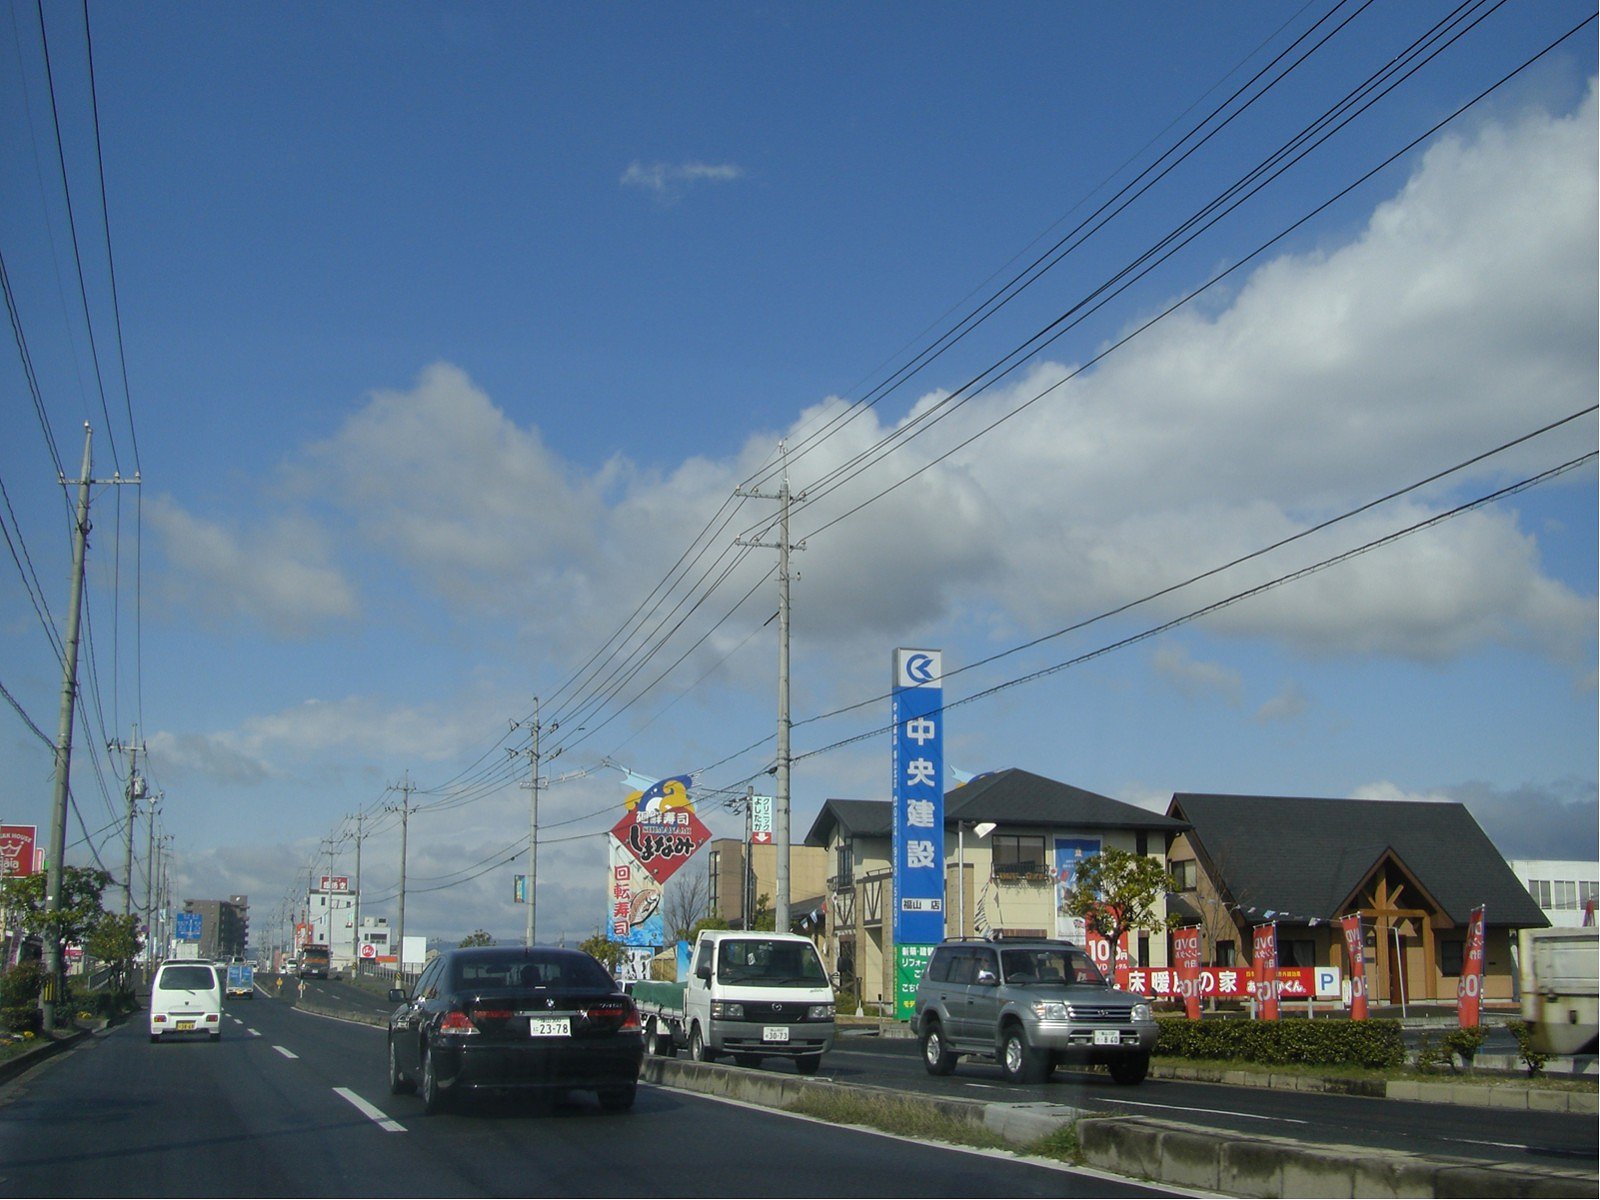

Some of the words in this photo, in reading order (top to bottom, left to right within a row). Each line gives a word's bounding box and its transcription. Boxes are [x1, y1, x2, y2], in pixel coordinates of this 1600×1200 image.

[906, 717, 935, 868] 中央建設
[754, 798, 762, 831] よしたか
[763, 798, 771, 831] クリニック
[630, 823, 696, 862] しまなみ
[613, 865, 632, 937] 回転寿司
[903, 901, 922, 910] 福山
[931, 901, 940, 910] 店
[1321, 974, 1333, 990] P
[540, 1024, 569, 1034] 23-78
